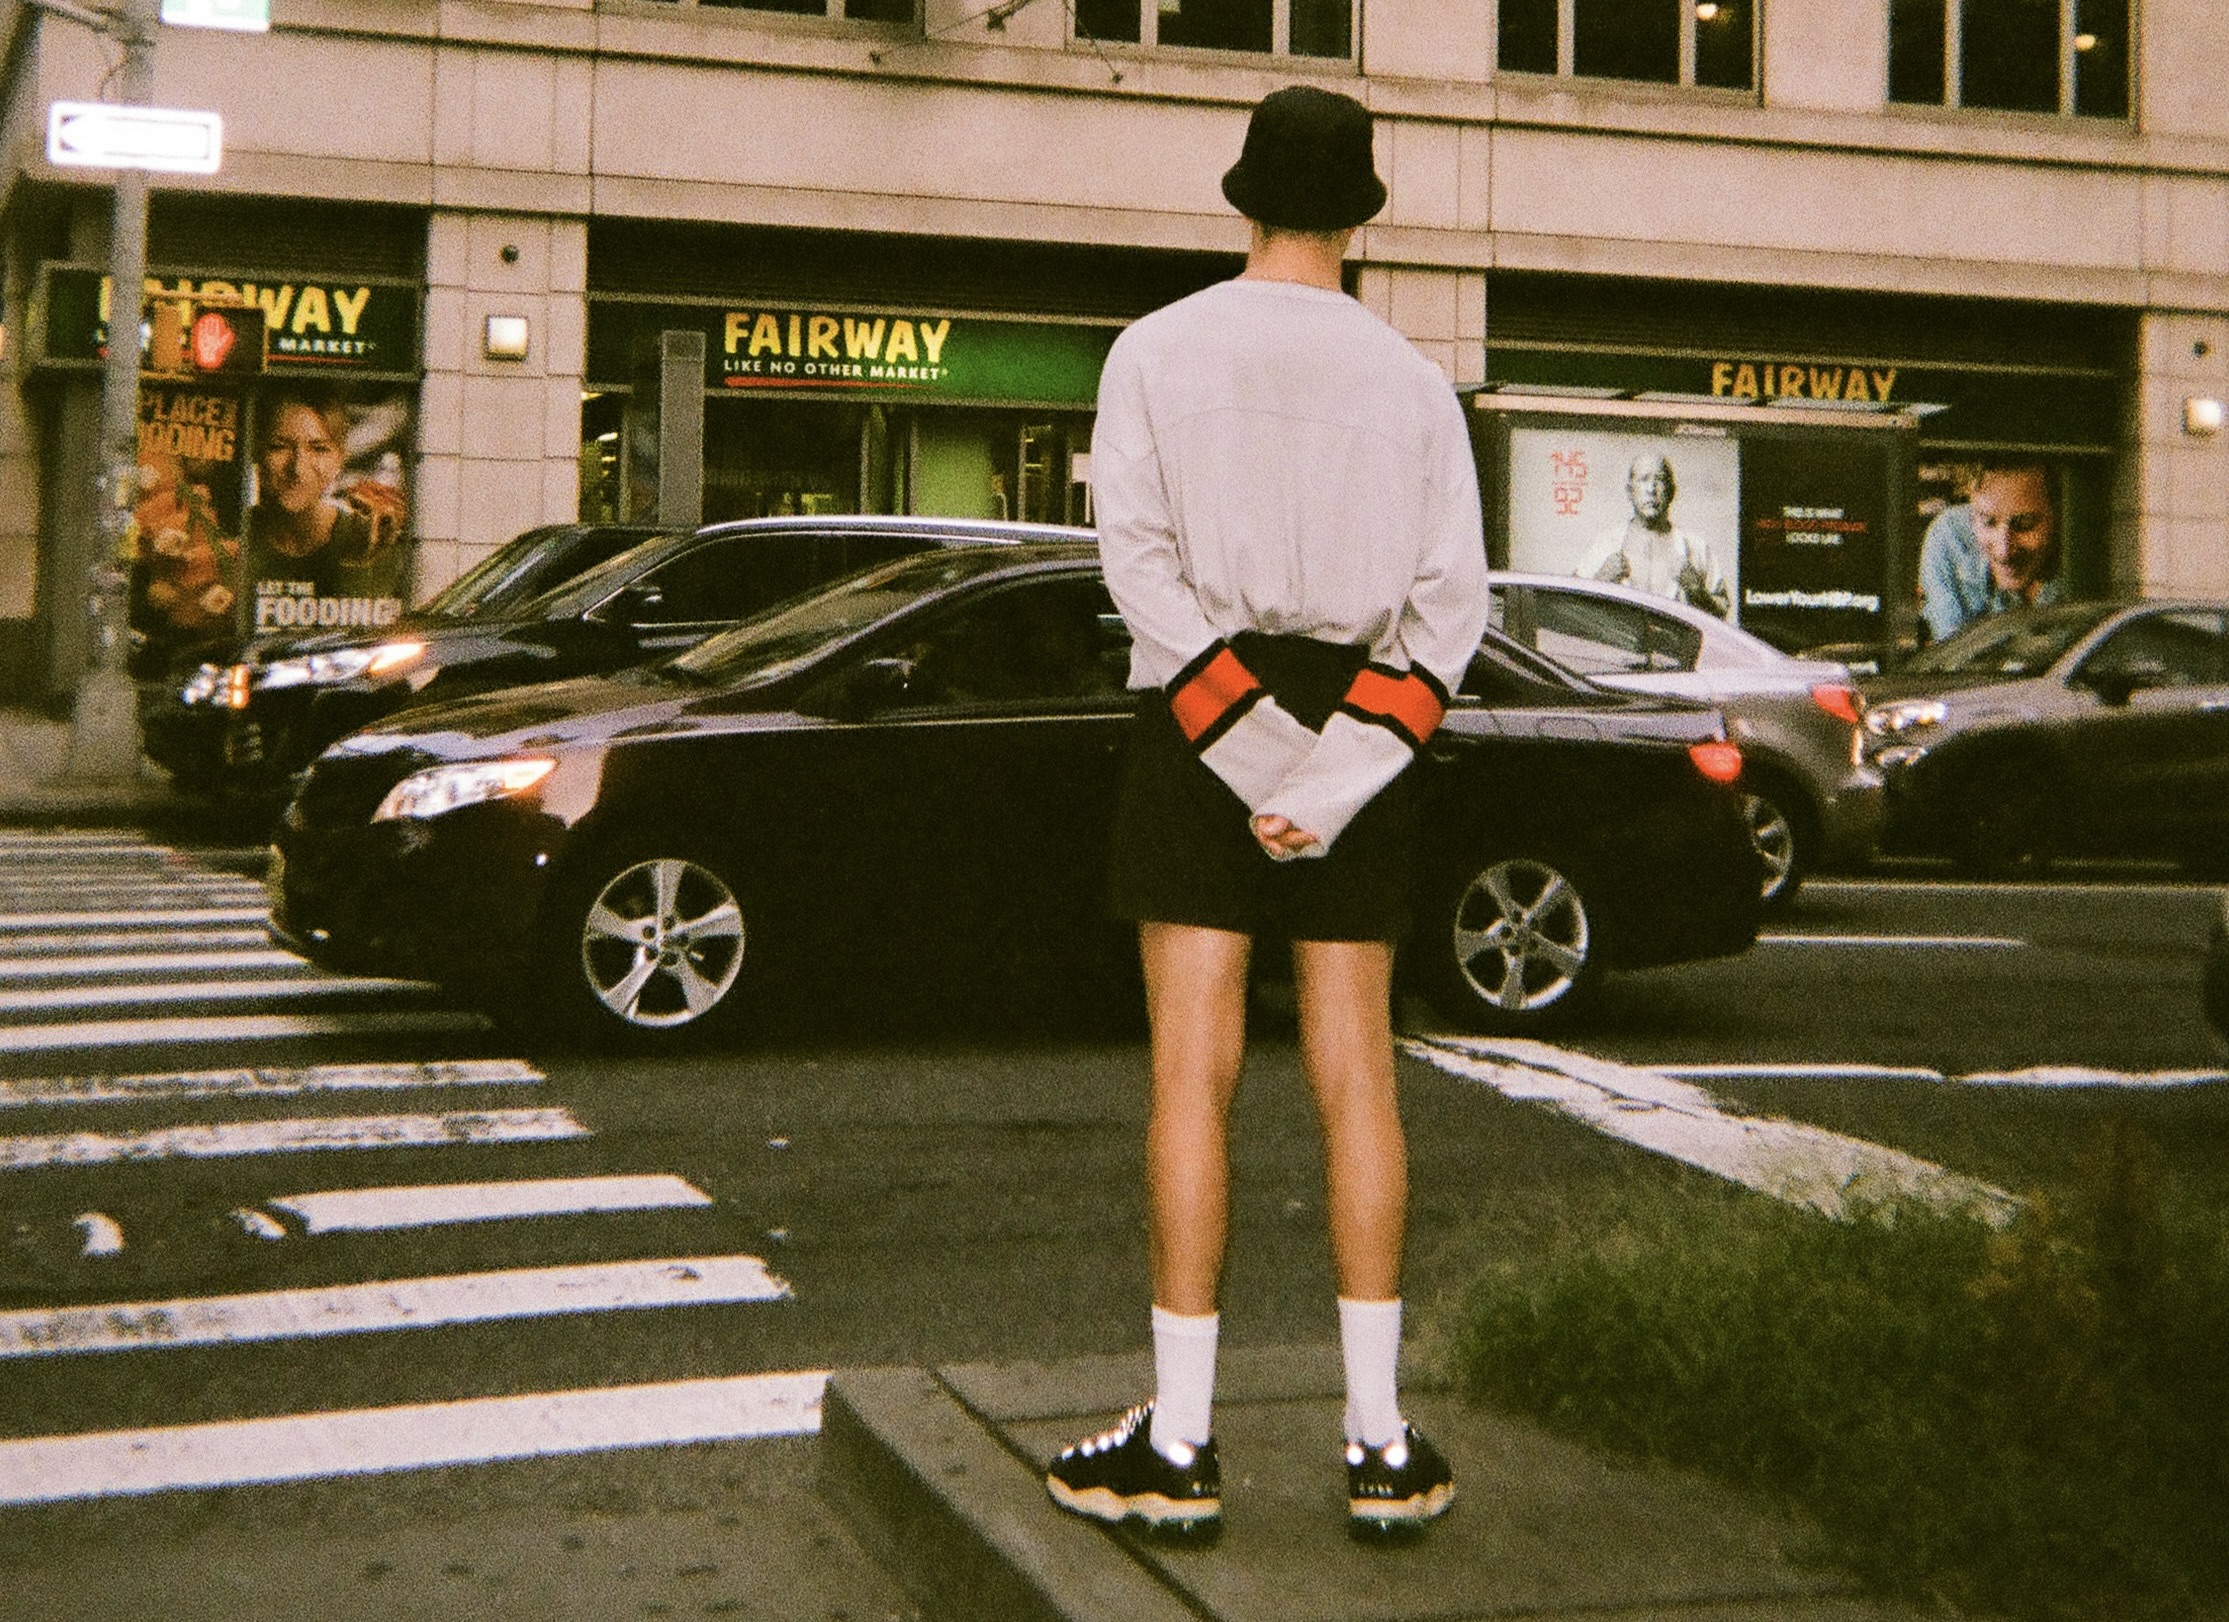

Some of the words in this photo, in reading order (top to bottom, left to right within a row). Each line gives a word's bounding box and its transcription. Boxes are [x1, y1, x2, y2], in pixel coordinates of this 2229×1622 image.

[278, 338, 367, 354] MARKET
[724, 312, 951, 363] FAIRWAY
[724, 359, 761, 373] LIKE
[770, 361, 795, 374] NO
[804, 362, 863, 377] OTHER
[869, 365, 940, 380] MARKET
[1712, 361, 1897, 403] FAIRWAY
